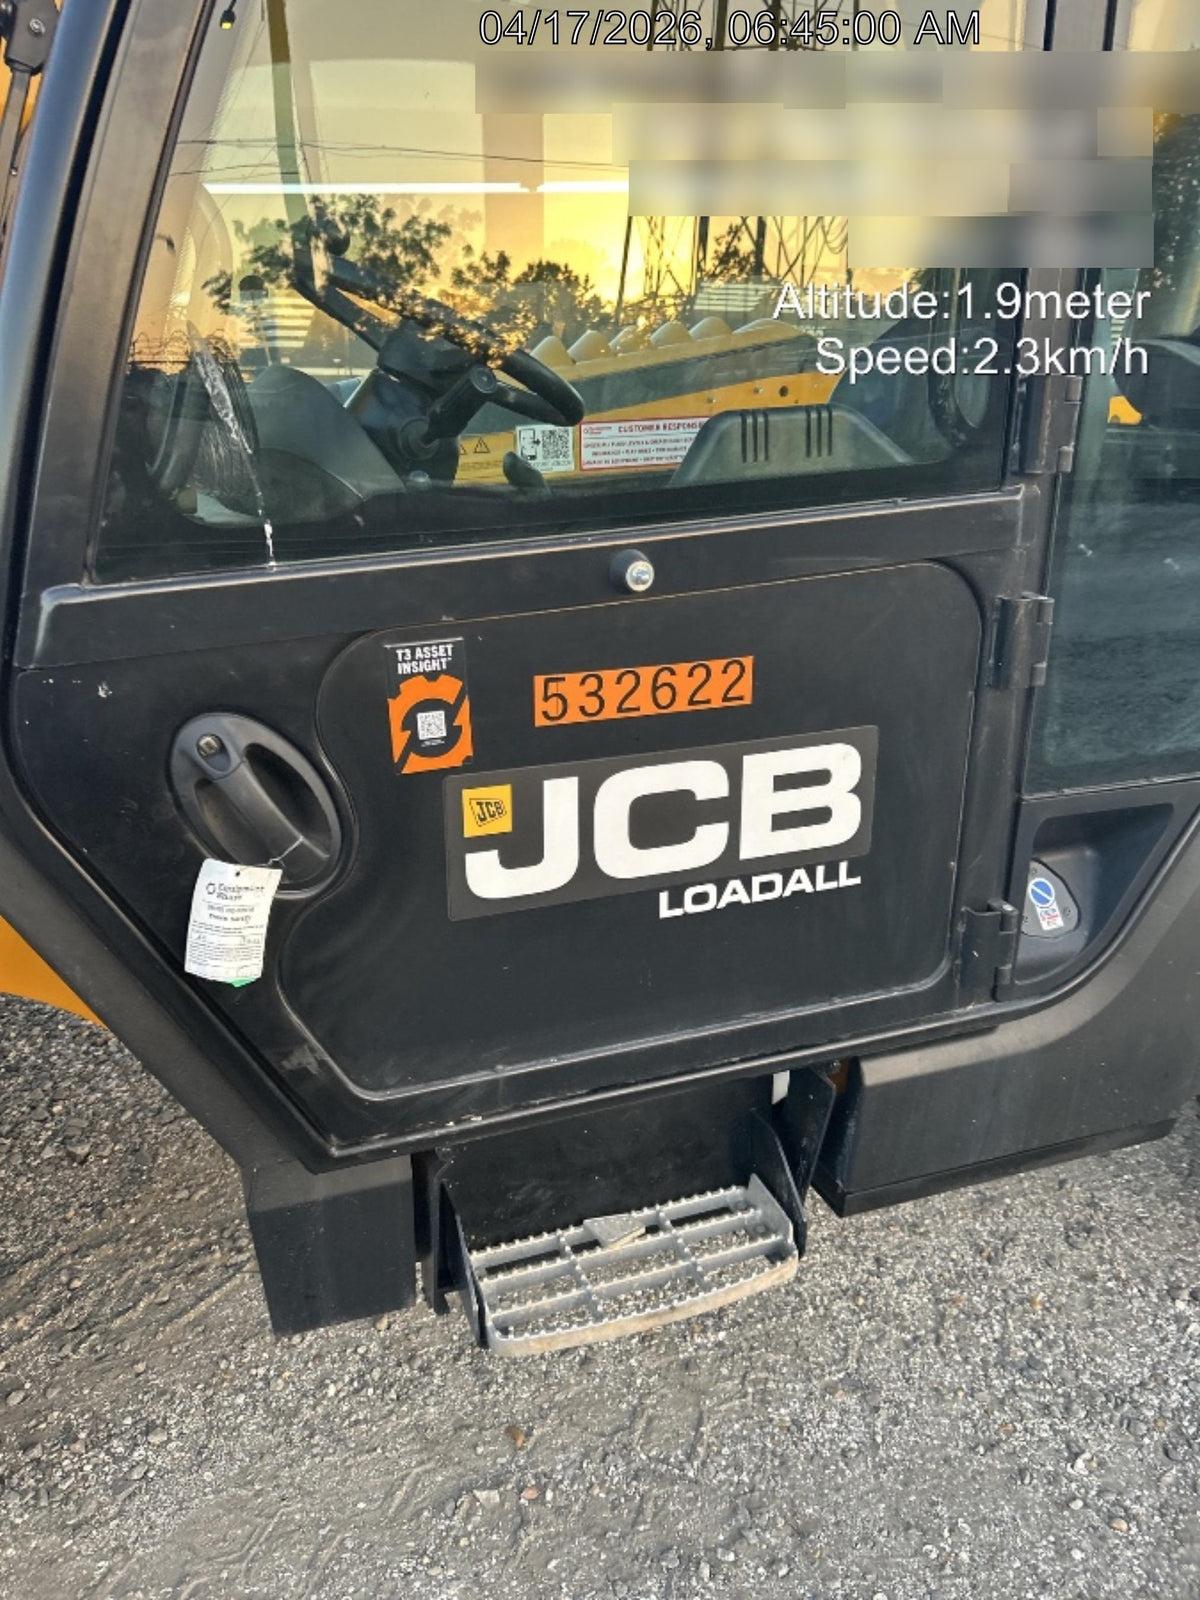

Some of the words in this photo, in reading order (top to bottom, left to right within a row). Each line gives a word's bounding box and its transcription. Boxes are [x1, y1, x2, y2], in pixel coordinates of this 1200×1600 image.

[396, 648, 411, 662] T3
[415, 644, 454, 660] ASSET
[397, 658, 447, 674] INSIGHT
[541, 659, 747, 722] 532622
[465, 743, 862, 899] JCB
[476, 801, 503, 822] JCB
[659, 860, 862, 919] LOADALL
